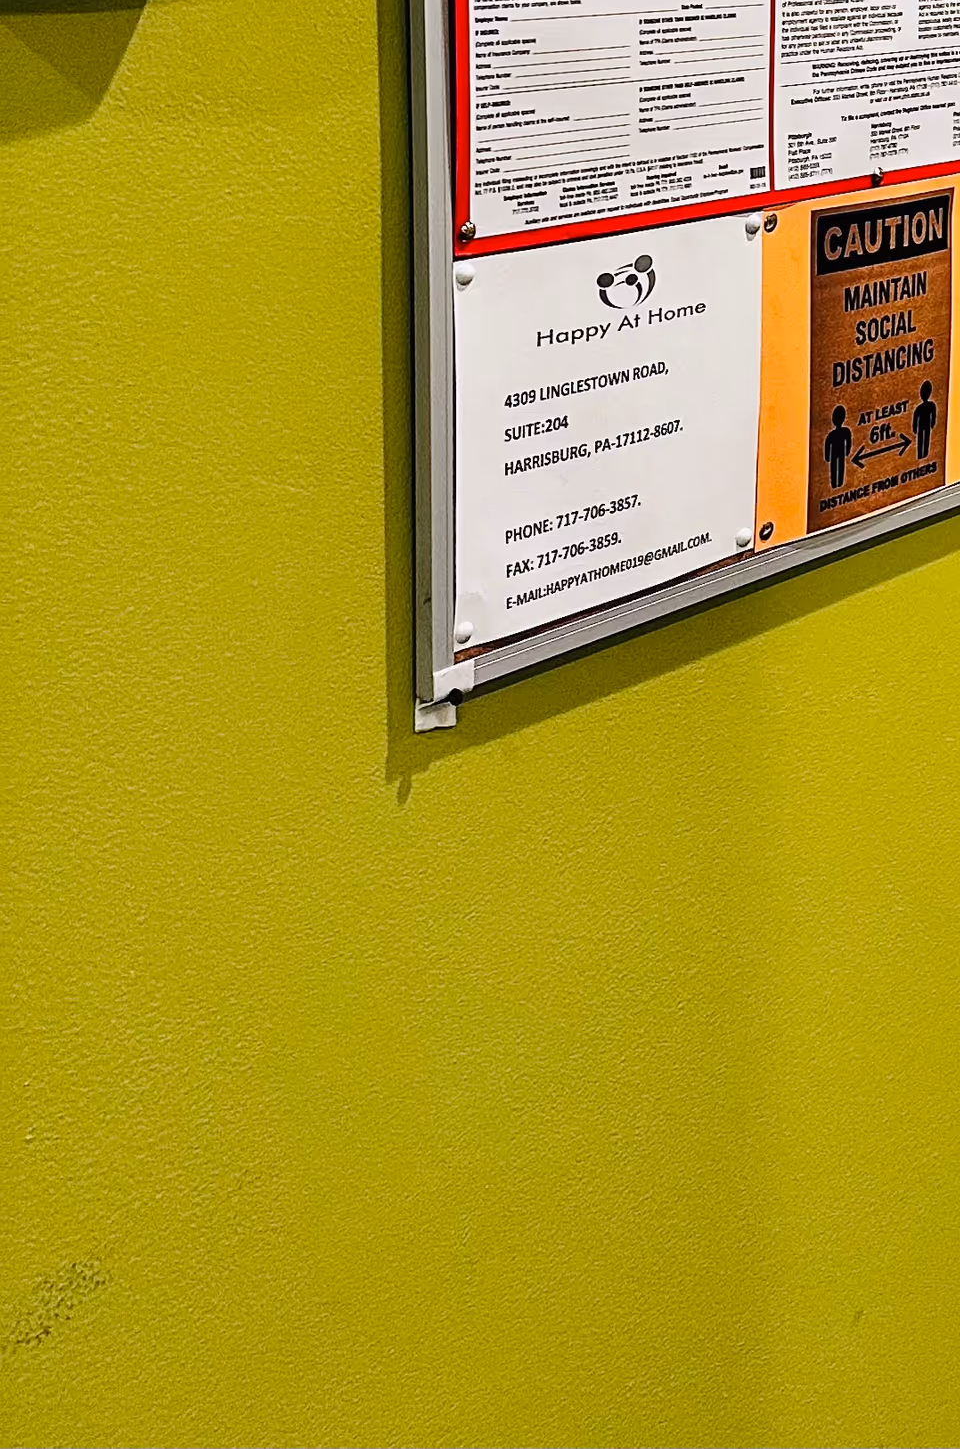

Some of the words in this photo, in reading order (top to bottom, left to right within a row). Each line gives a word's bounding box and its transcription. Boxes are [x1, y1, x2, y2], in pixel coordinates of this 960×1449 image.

[823, 211, 944, 261] CAUTION
[843, 271, 927, 313] MAINTAIN
[537, 323, 610, 346] Happy
[618, 314, 639, 331] At
[648, 303, 705, 323] Home
[855, 314, 917, 346] SOCIAL
[504, 389, 535, 407] 4309
[540, 370, 629, 400] LINGLESTOWN
[633, 361, 668, 379] ROAD,
[832, 339, 934, 388] DISTANCING
[504, 415, 568, 441] SUITE:204
[858, 411, 872, 426] AT
[875, 401, 908, 419] LEAST
[870, 424, 895, 444] 6ft.
[505, 444, 590, 474] HARRISBURG,
[595, 420, 682, 452] PA-17112-8607.
[820, 485, 870, 511] DISTANCE
[872, 475, 898, 493] FROM
[902, 462, 937, 482] OTHERS
[505, 519, 552, 543] PHONE:
[556, 494, 640, 527] 717-706-3857.
[506, 558, 533, 577] FAX:
[537, 532, 621, 567] 717-706-3859.
[506, 534, 711, 607] E-MAIL:HAPPYATHOME019@GMAIL.COM.
